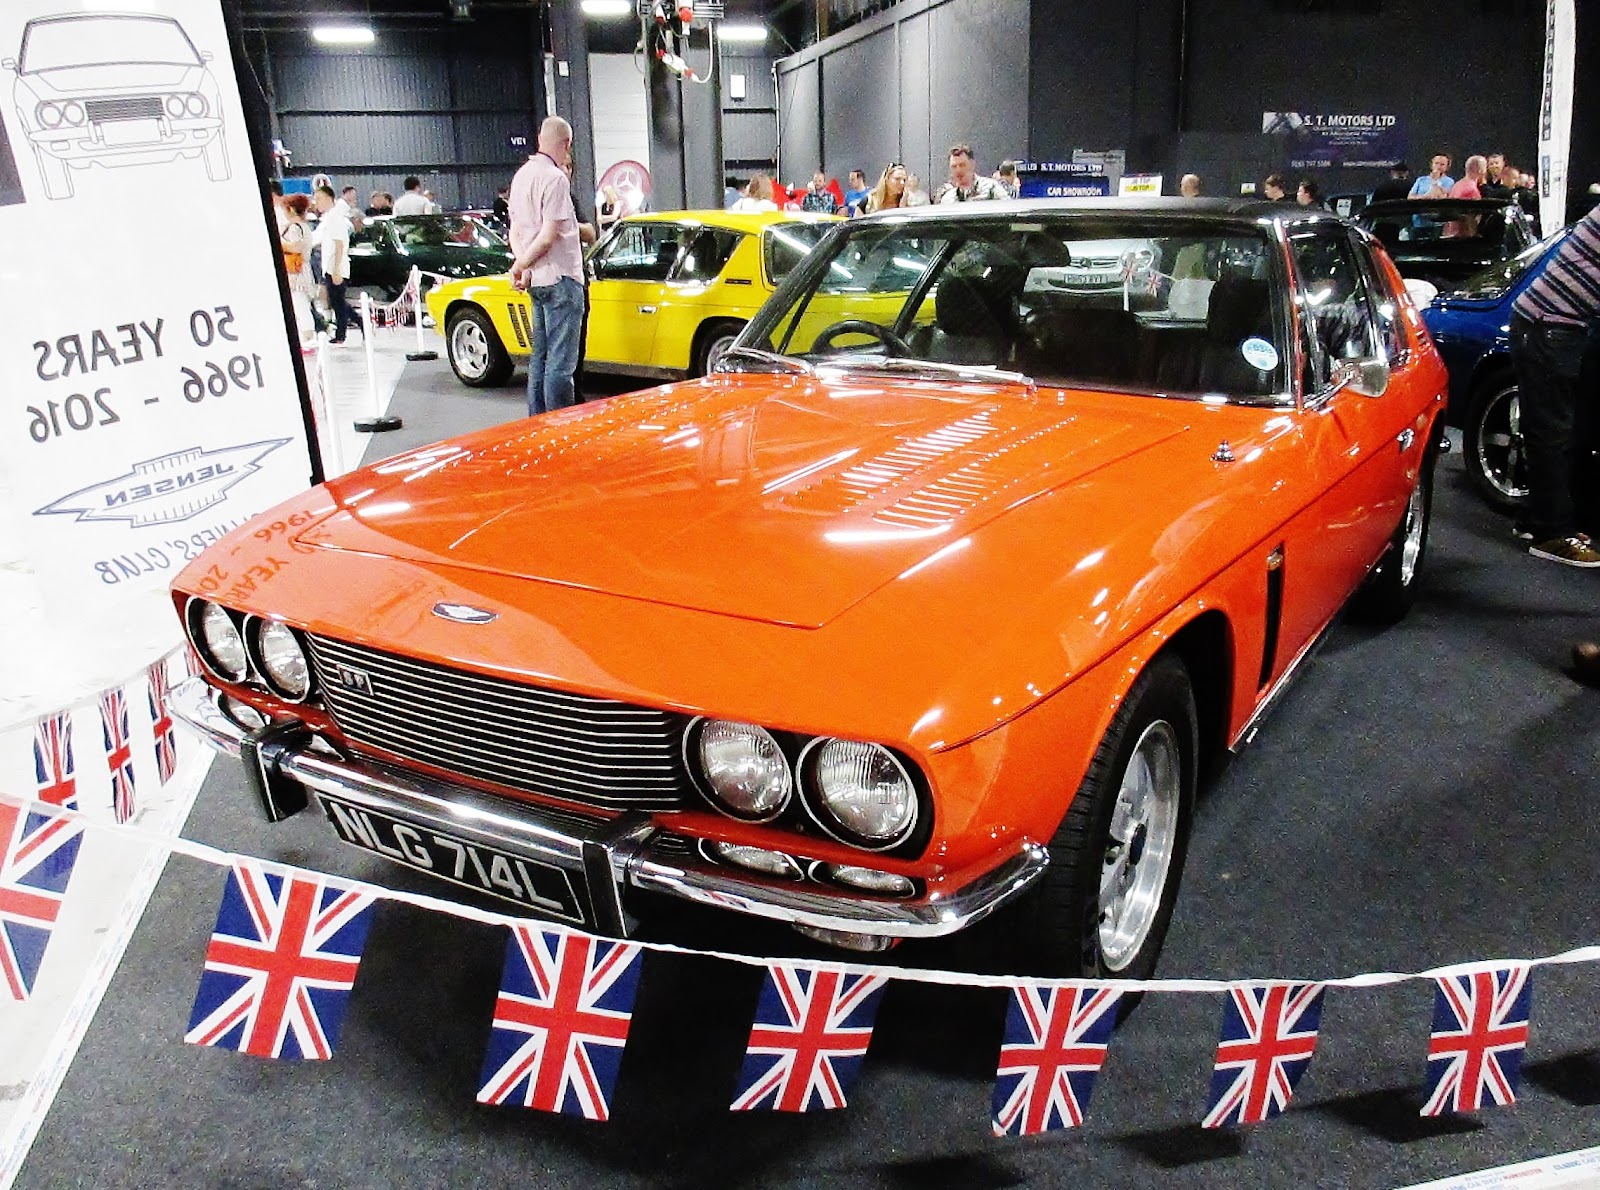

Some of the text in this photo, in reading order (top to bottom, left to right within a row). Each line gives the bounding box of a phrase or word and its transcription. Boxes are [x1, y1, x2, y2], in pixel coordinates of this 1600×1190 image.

[1328, 115, 1373, 126] MOTORS
[1375, 115, 1396, 126] LTD
[1056, 163, 1086, 171] MOTORS
[1047, 187, 1102, 196] CAR SHOWROOM
[330, 801, 564, 911] NLG 714L
